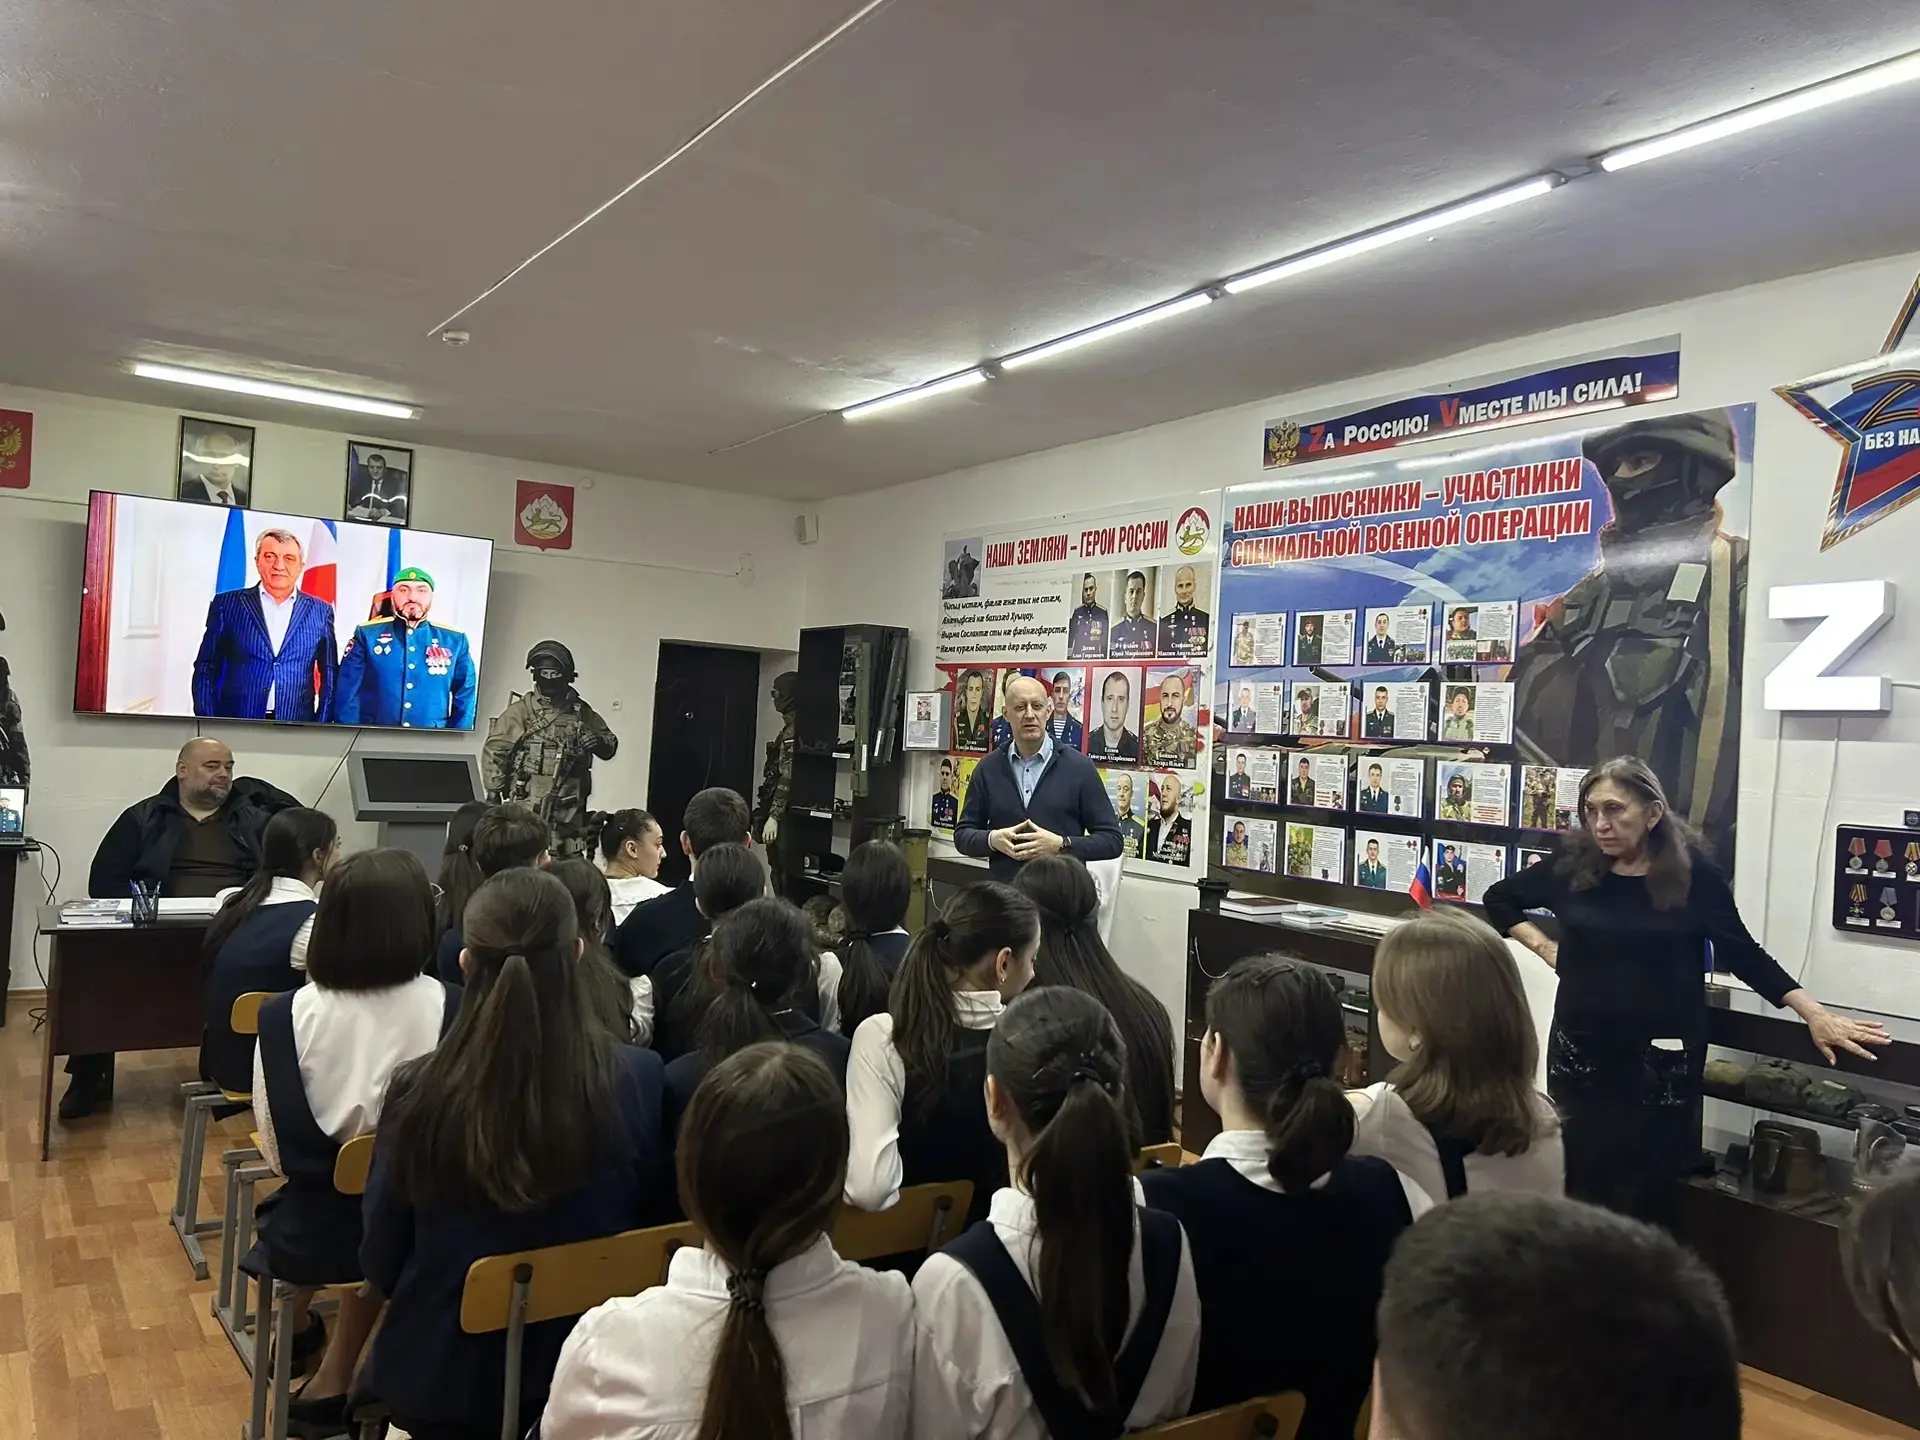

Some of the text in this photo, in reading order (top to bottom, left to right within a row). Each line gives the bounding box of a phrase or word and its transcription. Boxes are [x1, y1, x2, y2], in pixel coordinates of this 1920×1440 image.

[1528, 386, 1567, 412] МЫ
[1573, 372, 1643, 401] СИЛА!
[1865, 431, 1895, 450] БЕЗ
[1233, 501, 1285, 533] НАШИ
[1287, 481, 1422, 525] ВЫПУСКНИКИ
[1444, 457, 1583, 507] УЧАСТНИКИ
[986, 541, 1015, 568] НАШИ
[1017, 534, 1068, 565] ЗЕМЛЯКИ
[1080, 528, 1115, 558] ГЕРОИ
[1118, 520, 1169, 553] РОССИИ
[1232, 499, 1592, 568] СПЕЦИАЛЬНОЙ ВОЕННОЙ ОПЕРАЦИИ
[1764, 580, 1896, 711] Z
